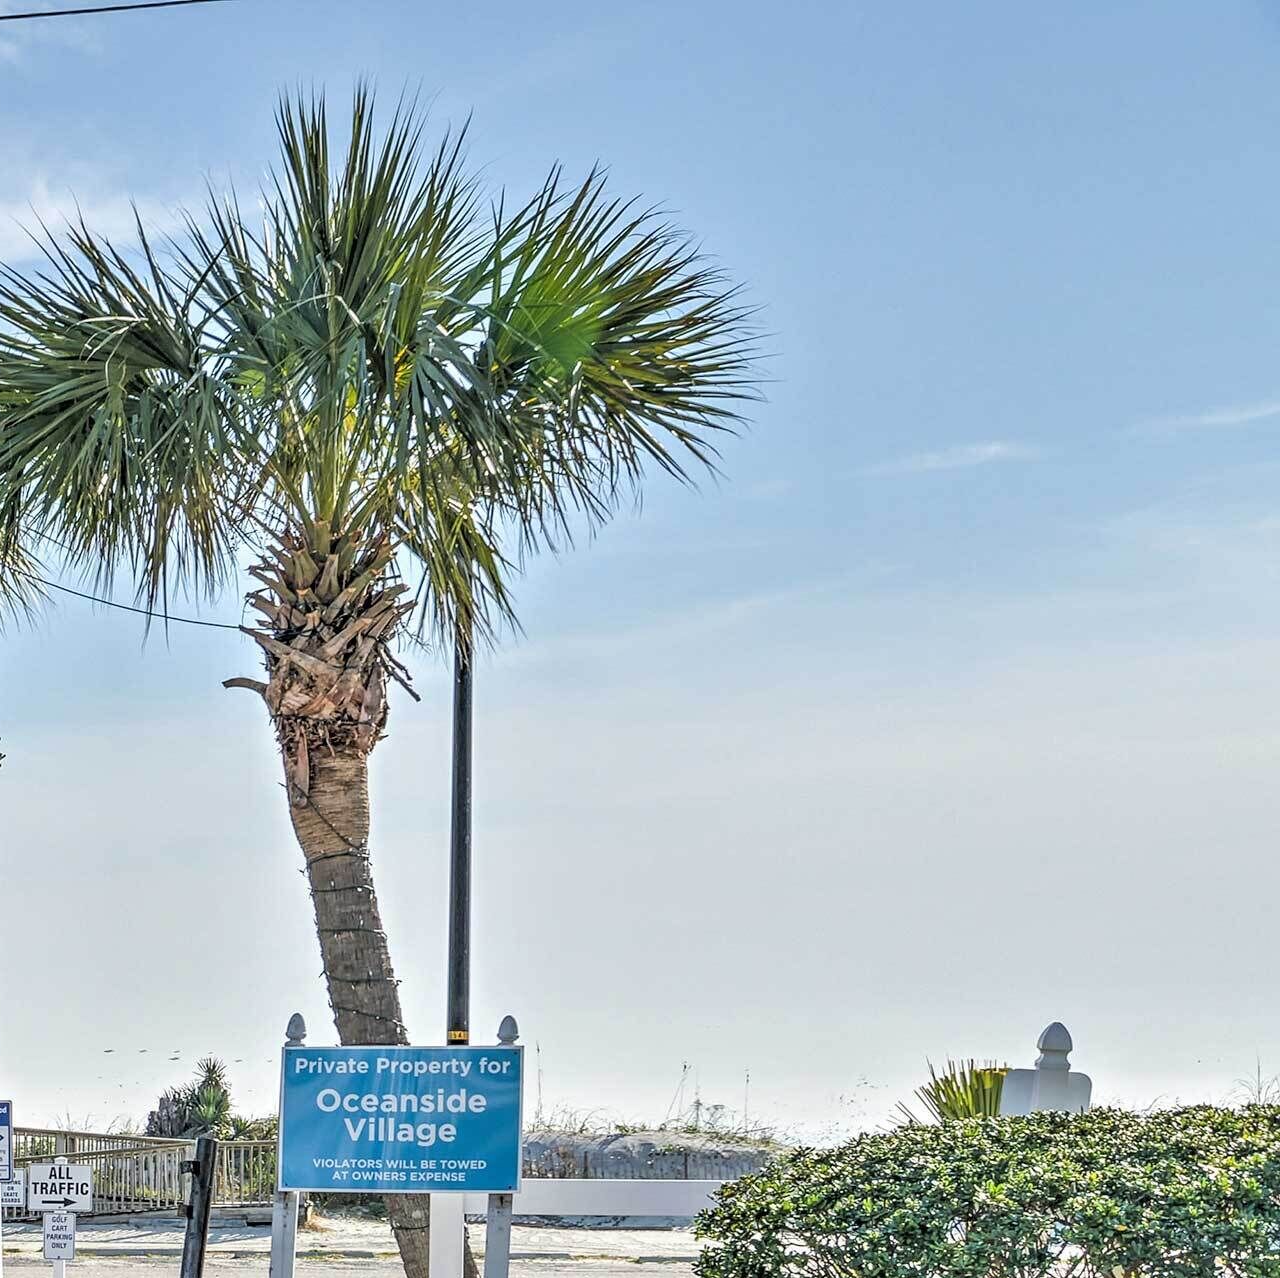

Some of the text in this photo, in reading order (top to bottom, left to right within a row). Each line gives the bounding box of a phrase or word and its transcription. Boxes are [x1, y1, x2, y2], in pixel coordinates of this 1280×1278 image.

[295, 1057, 511, 1077] Private Property for
[316, 1088, 487, 1113] Oceanside
[344, 1117, 457, 1147] Village
[312, 1159, 487, 1170] VIOLATORS WILL BE TOWED
[48, 1166, 73, 1180] ALL
[332, 1171, 466, 1182] AT OWNERS EXPENSE
[31, 1182, 89, 1196] TRAFFIC
[46, 1233, 73, 1241] PARKING
